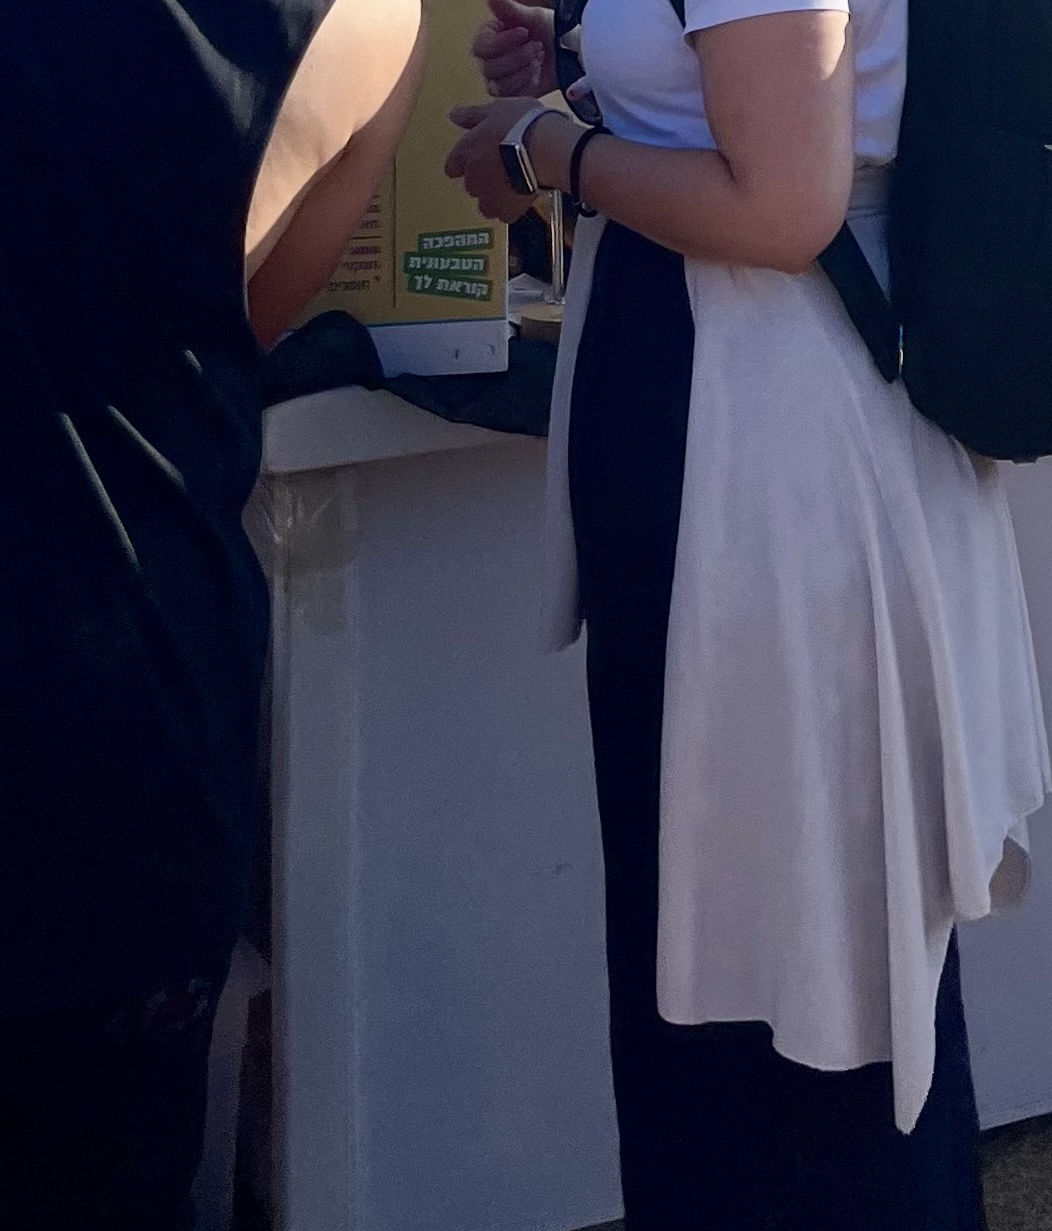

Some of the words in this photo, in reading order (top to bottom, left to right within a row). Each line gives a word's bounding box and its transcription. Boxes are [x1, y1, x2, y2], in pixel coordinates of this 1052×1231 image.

[422, 232, 490, 250] המהפכה
[408, 256, 485, 272] הטבעונית
[414, 273, 433, 290] לך
[436, 278, 489, 299] קוראת
